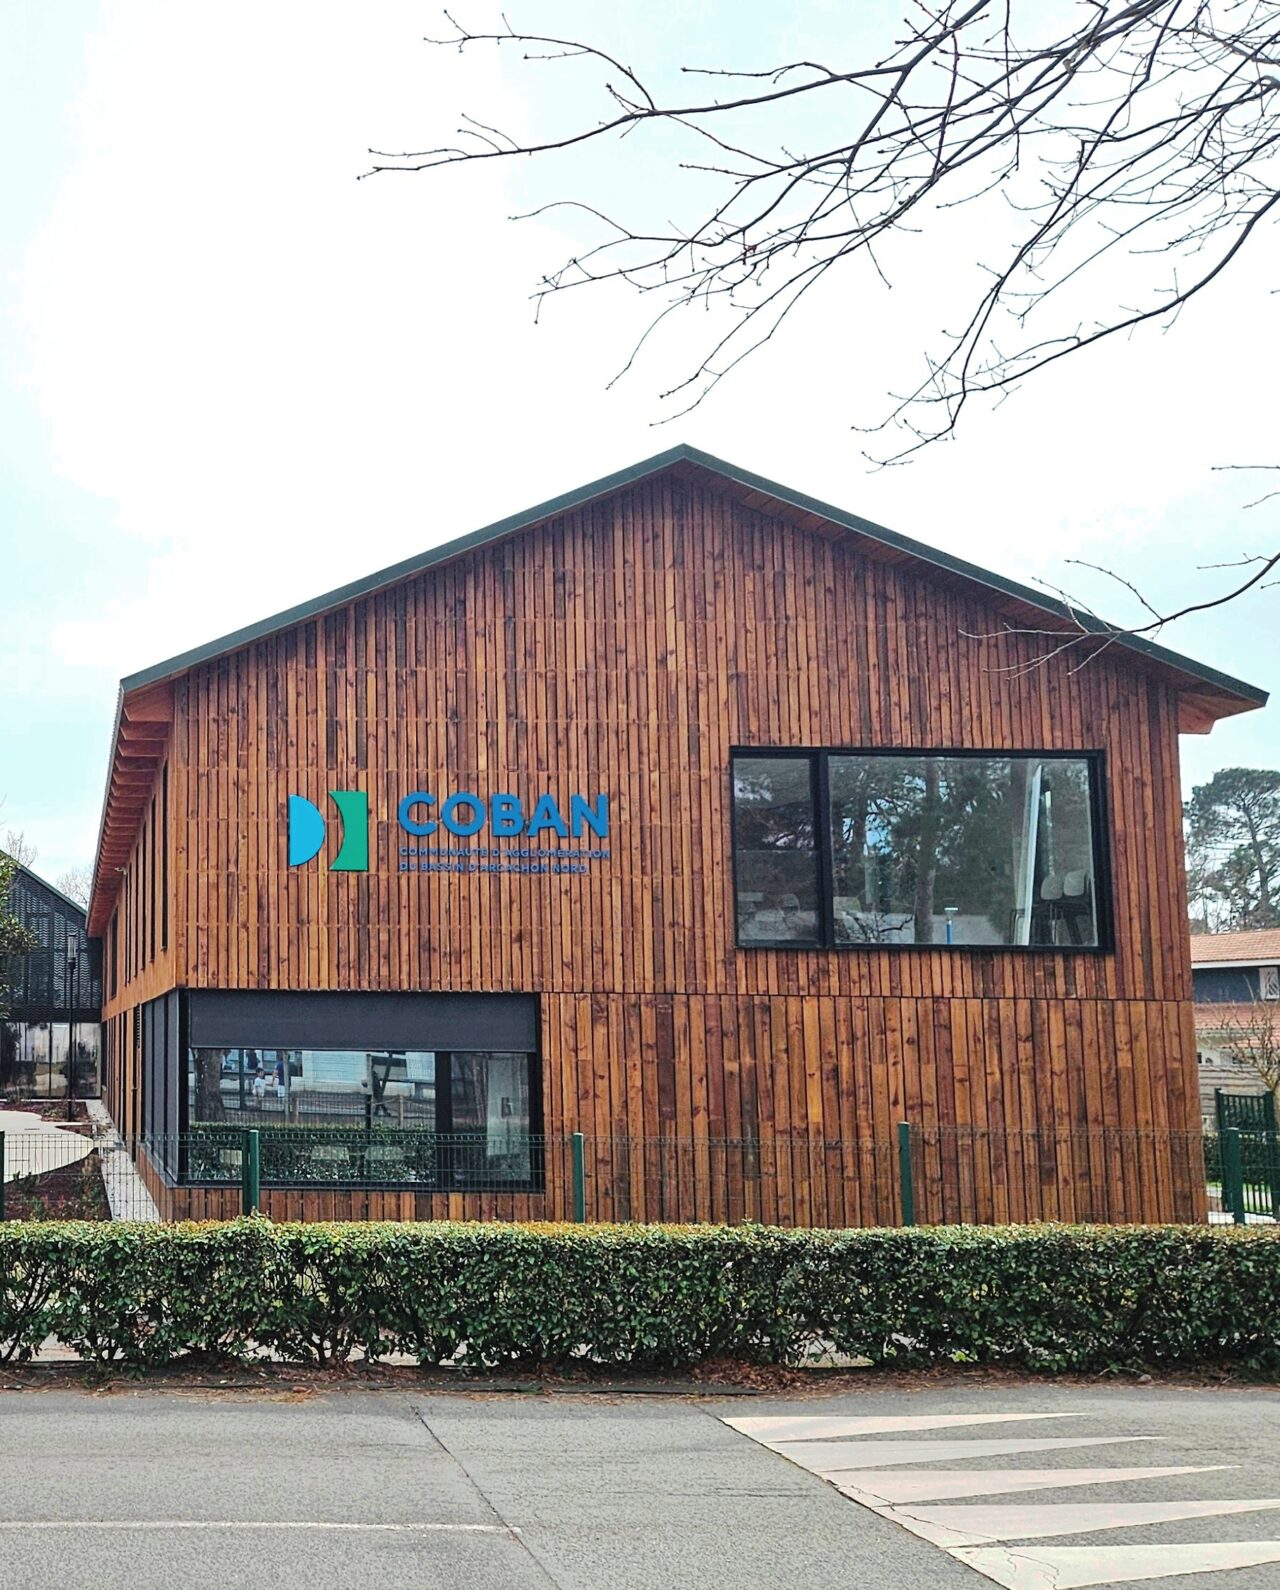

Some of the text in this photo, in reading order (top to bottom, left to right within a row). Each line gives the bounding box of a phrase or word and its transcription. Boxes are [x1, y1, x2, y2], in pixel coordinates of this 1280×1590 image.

[398, 791, 609, 838] COBAN
[400, 861, 588, 874] DU BASSIN D'ARCACHON NORD
